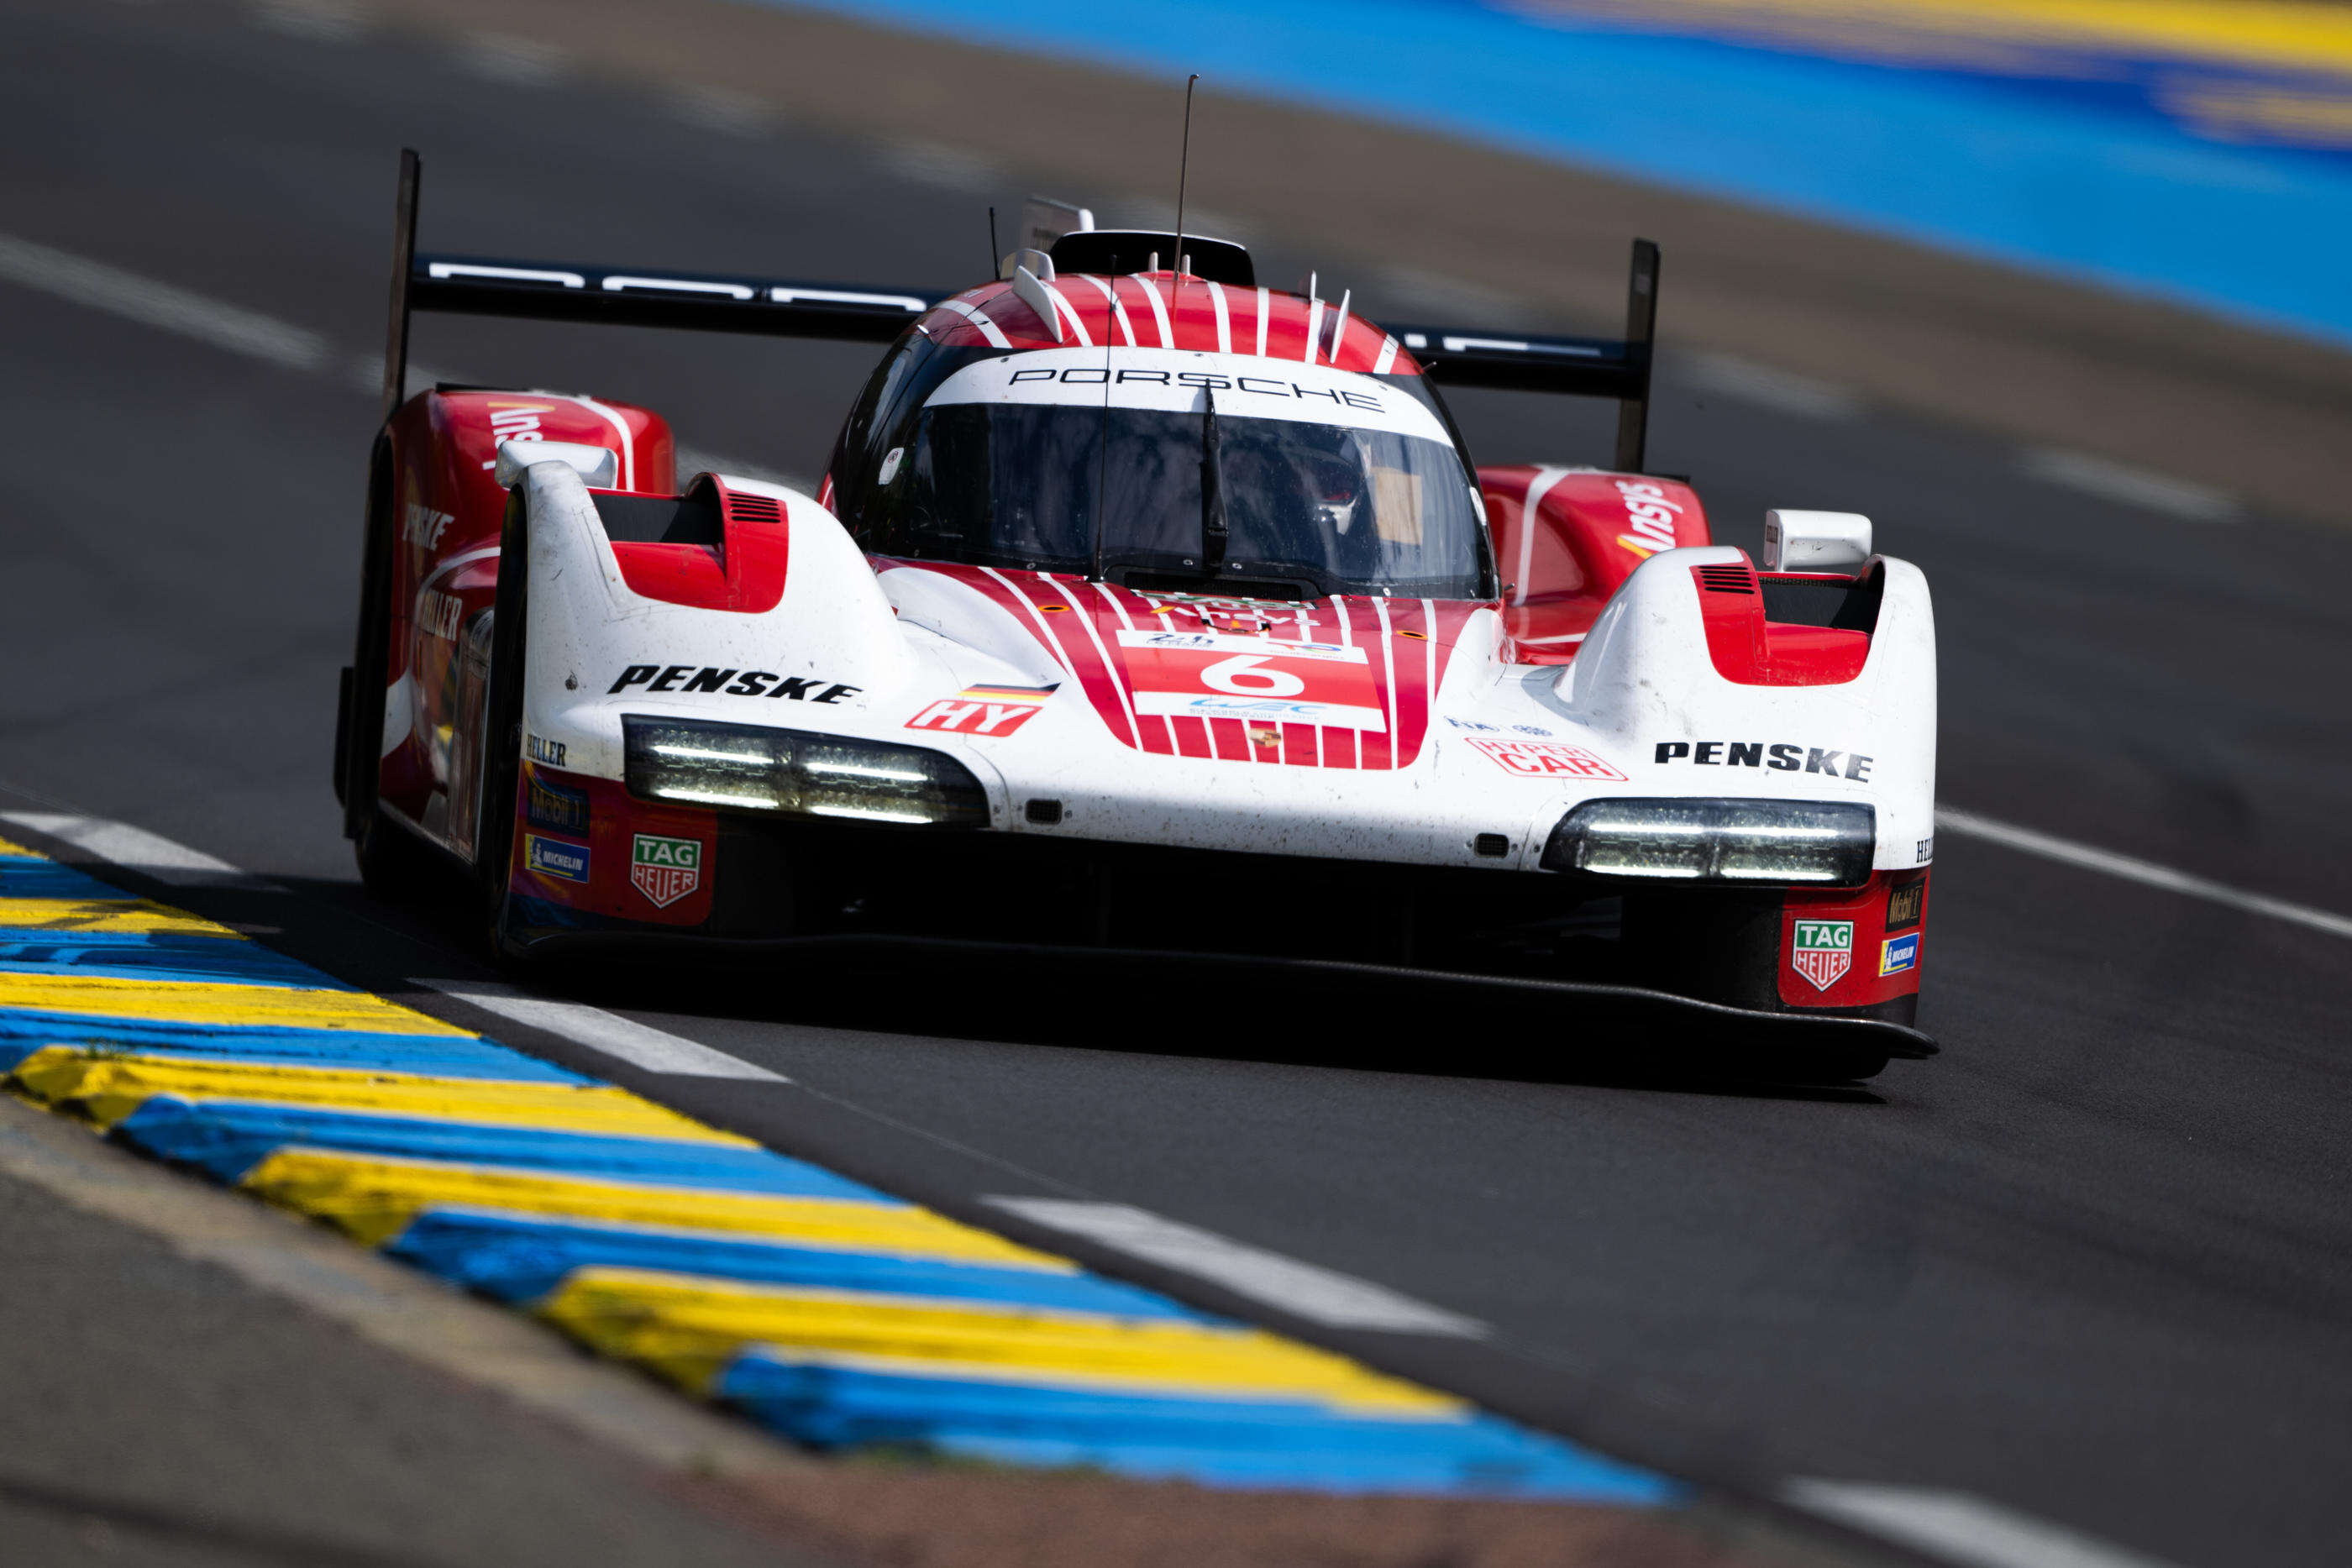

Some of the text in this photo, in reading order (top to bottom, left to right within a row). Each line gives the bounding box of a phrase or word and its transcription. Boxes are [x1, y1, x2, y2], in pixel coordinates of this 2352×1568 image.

[1009, 369, 1386, 413] PORSCHE
[607, 665, 863, 704] PENSKE
[1200, 654, 1305, 697] 6
[911, 701, 1035, 732] HY
[527, 733, 566, 767] HELLER
[1478, 741, 1588, 758] HYPER
[1499, 753, 1614, 776] CAR
[1654, 742, 1874, 784] PENSKE
[543, 851, 583, 871] MICHELIN
[639, 841, 693, 866] TAG
[635, 865, 693, 901] HEUER
[1890, 891, 1913, 924] Mobil
[1800, 926, 1848, 947] TAG
[1797, 952, 1847, 985] HEUER
